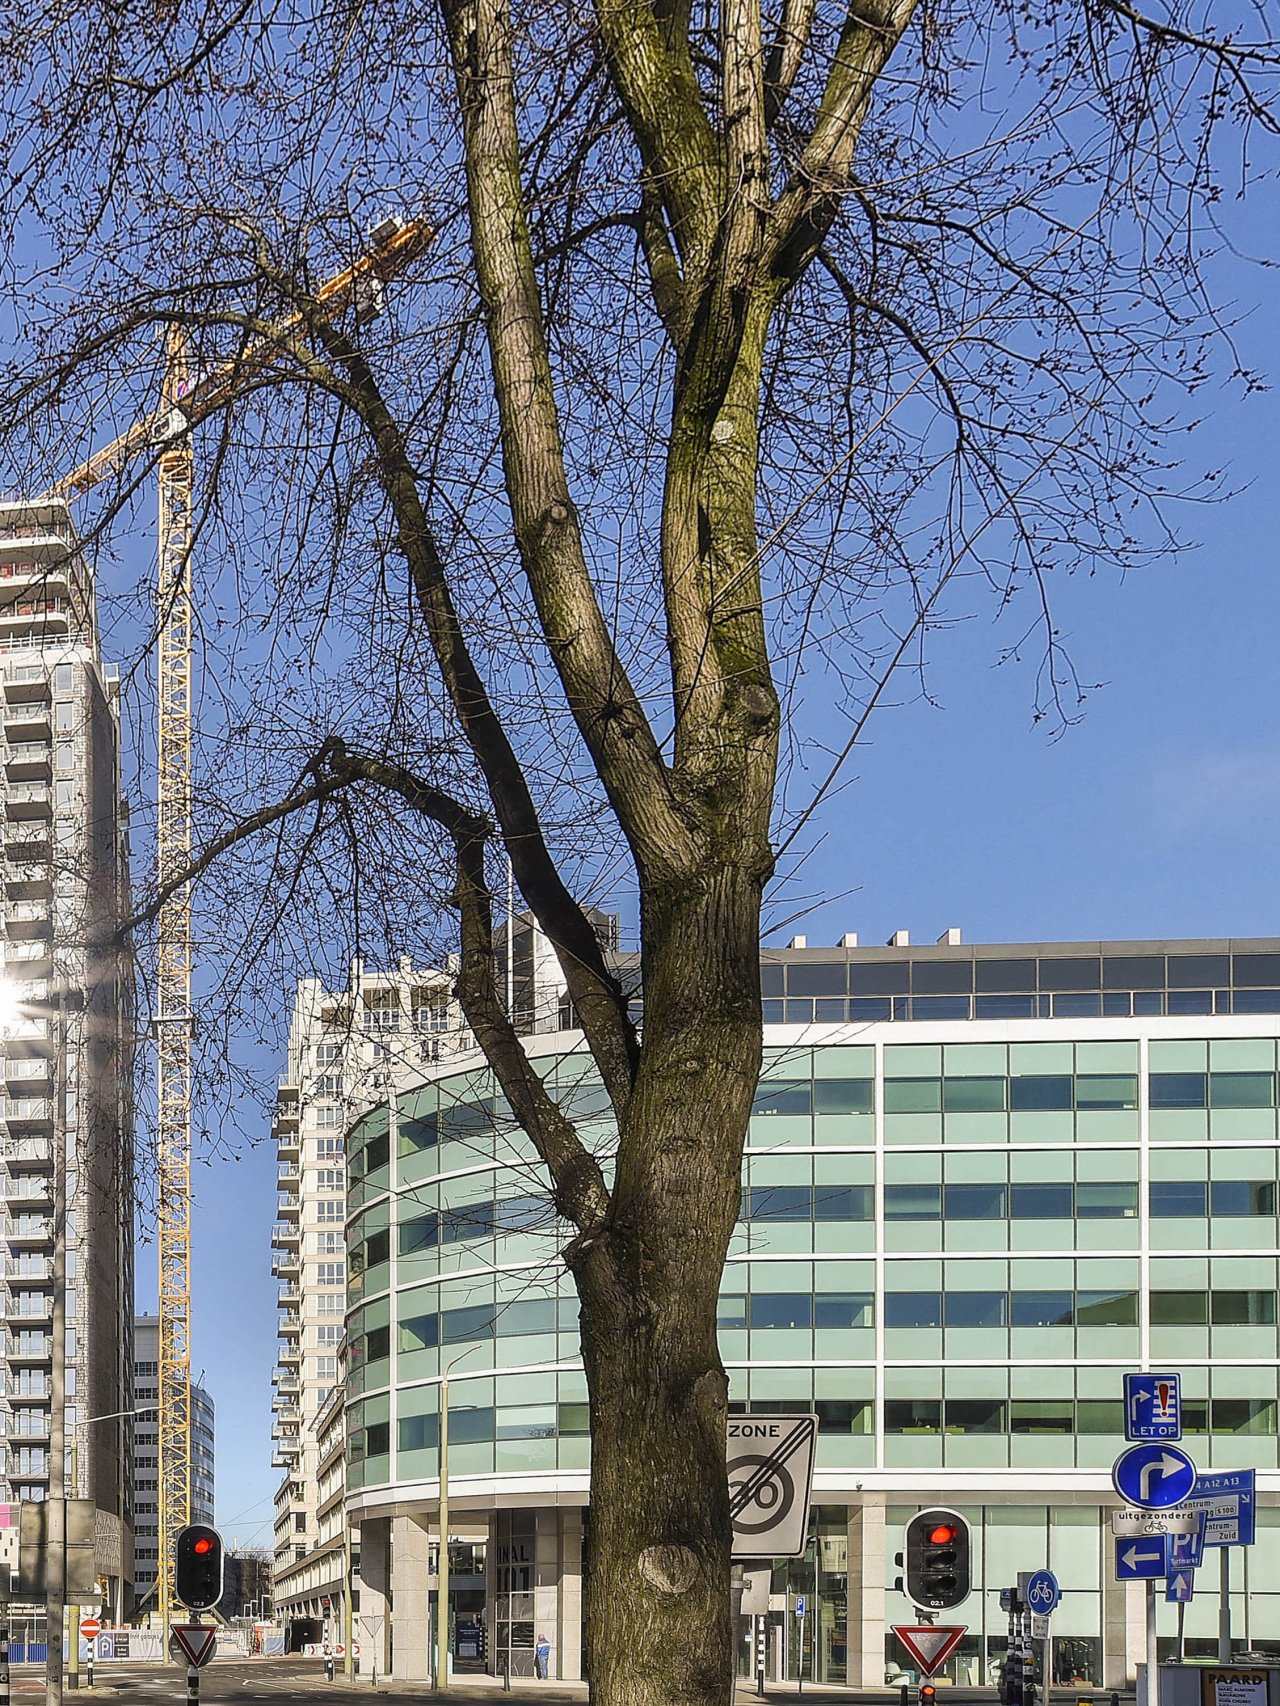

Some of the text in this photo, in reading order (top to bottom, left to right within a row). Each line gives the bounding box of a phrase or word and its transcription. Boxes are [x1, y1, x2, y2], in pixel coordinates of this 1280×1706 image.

[728, 1425, 780, 1438] ZONE
[1132, 1427, 1177, 1435] LET OP
[1118, 1512, 1194, 1521] uitgezonderd
[1219, 1531, 1237, 1540] Zuid
[1208, 1673, 1263, 1685] PAARD
